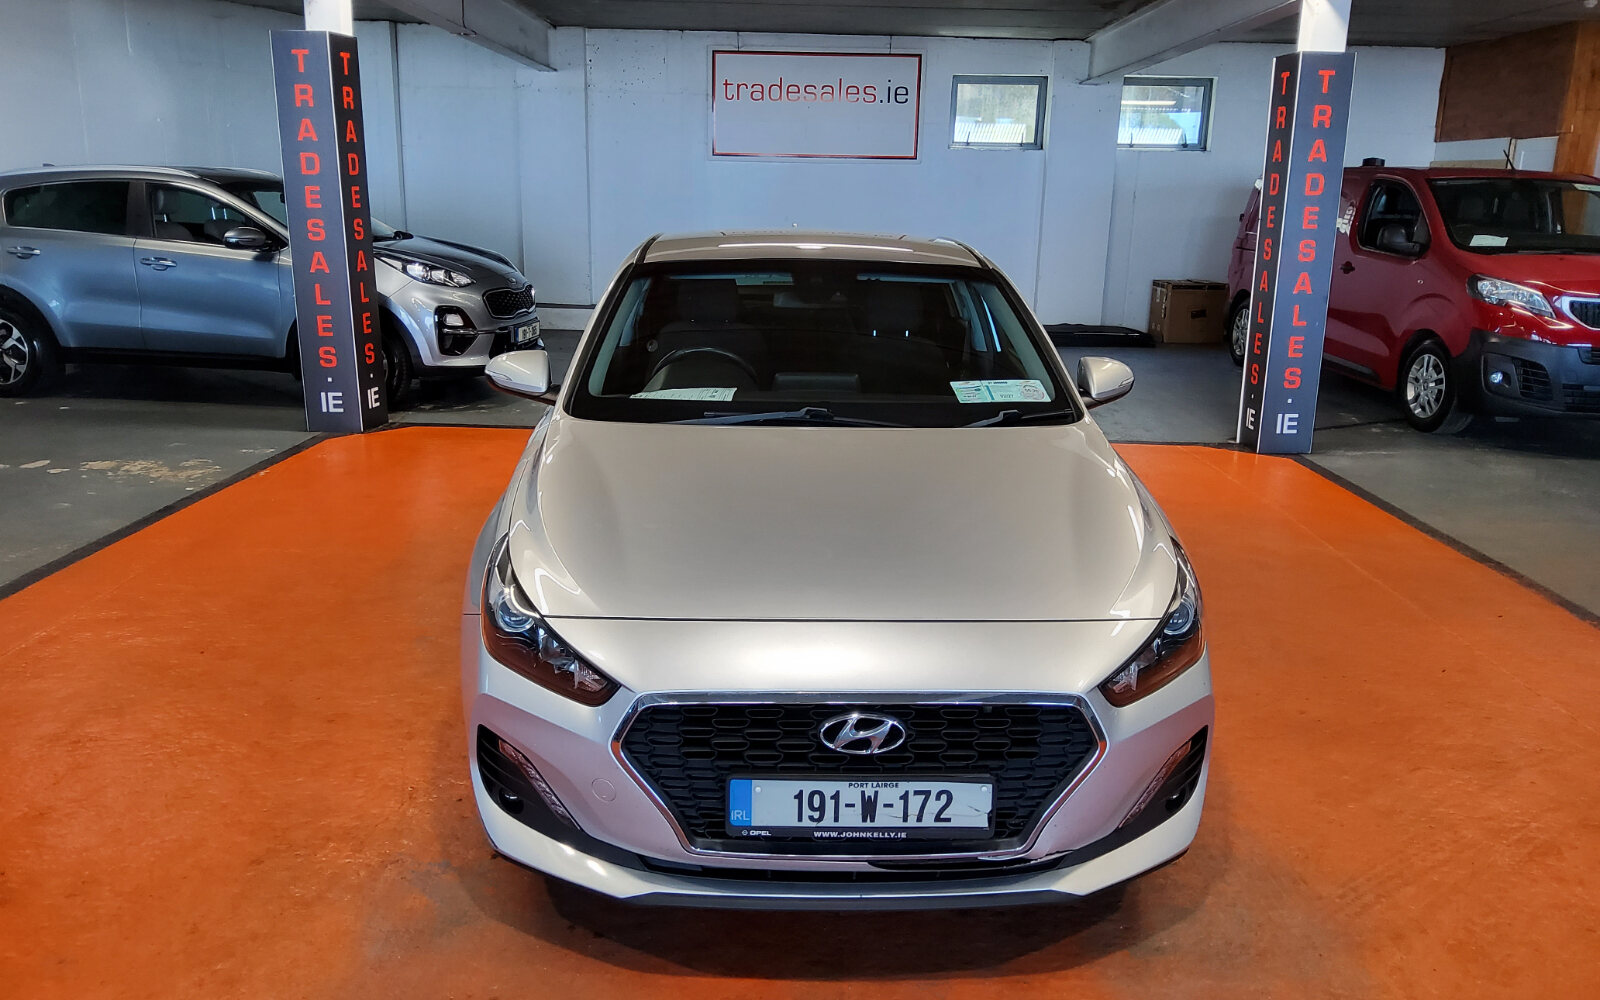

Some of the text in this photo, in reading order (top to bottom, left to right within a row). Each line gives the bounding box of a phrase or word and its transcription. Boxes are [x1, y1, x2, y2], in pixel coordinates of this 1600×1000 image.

[723, 77, 909, 104] tradesales.ie
[731, 810, 750, 821] IRL
[793, 789, 953, 823] 191-W-172
[813, 831, 907, 839] WWW.JOHNKELLY.IE
